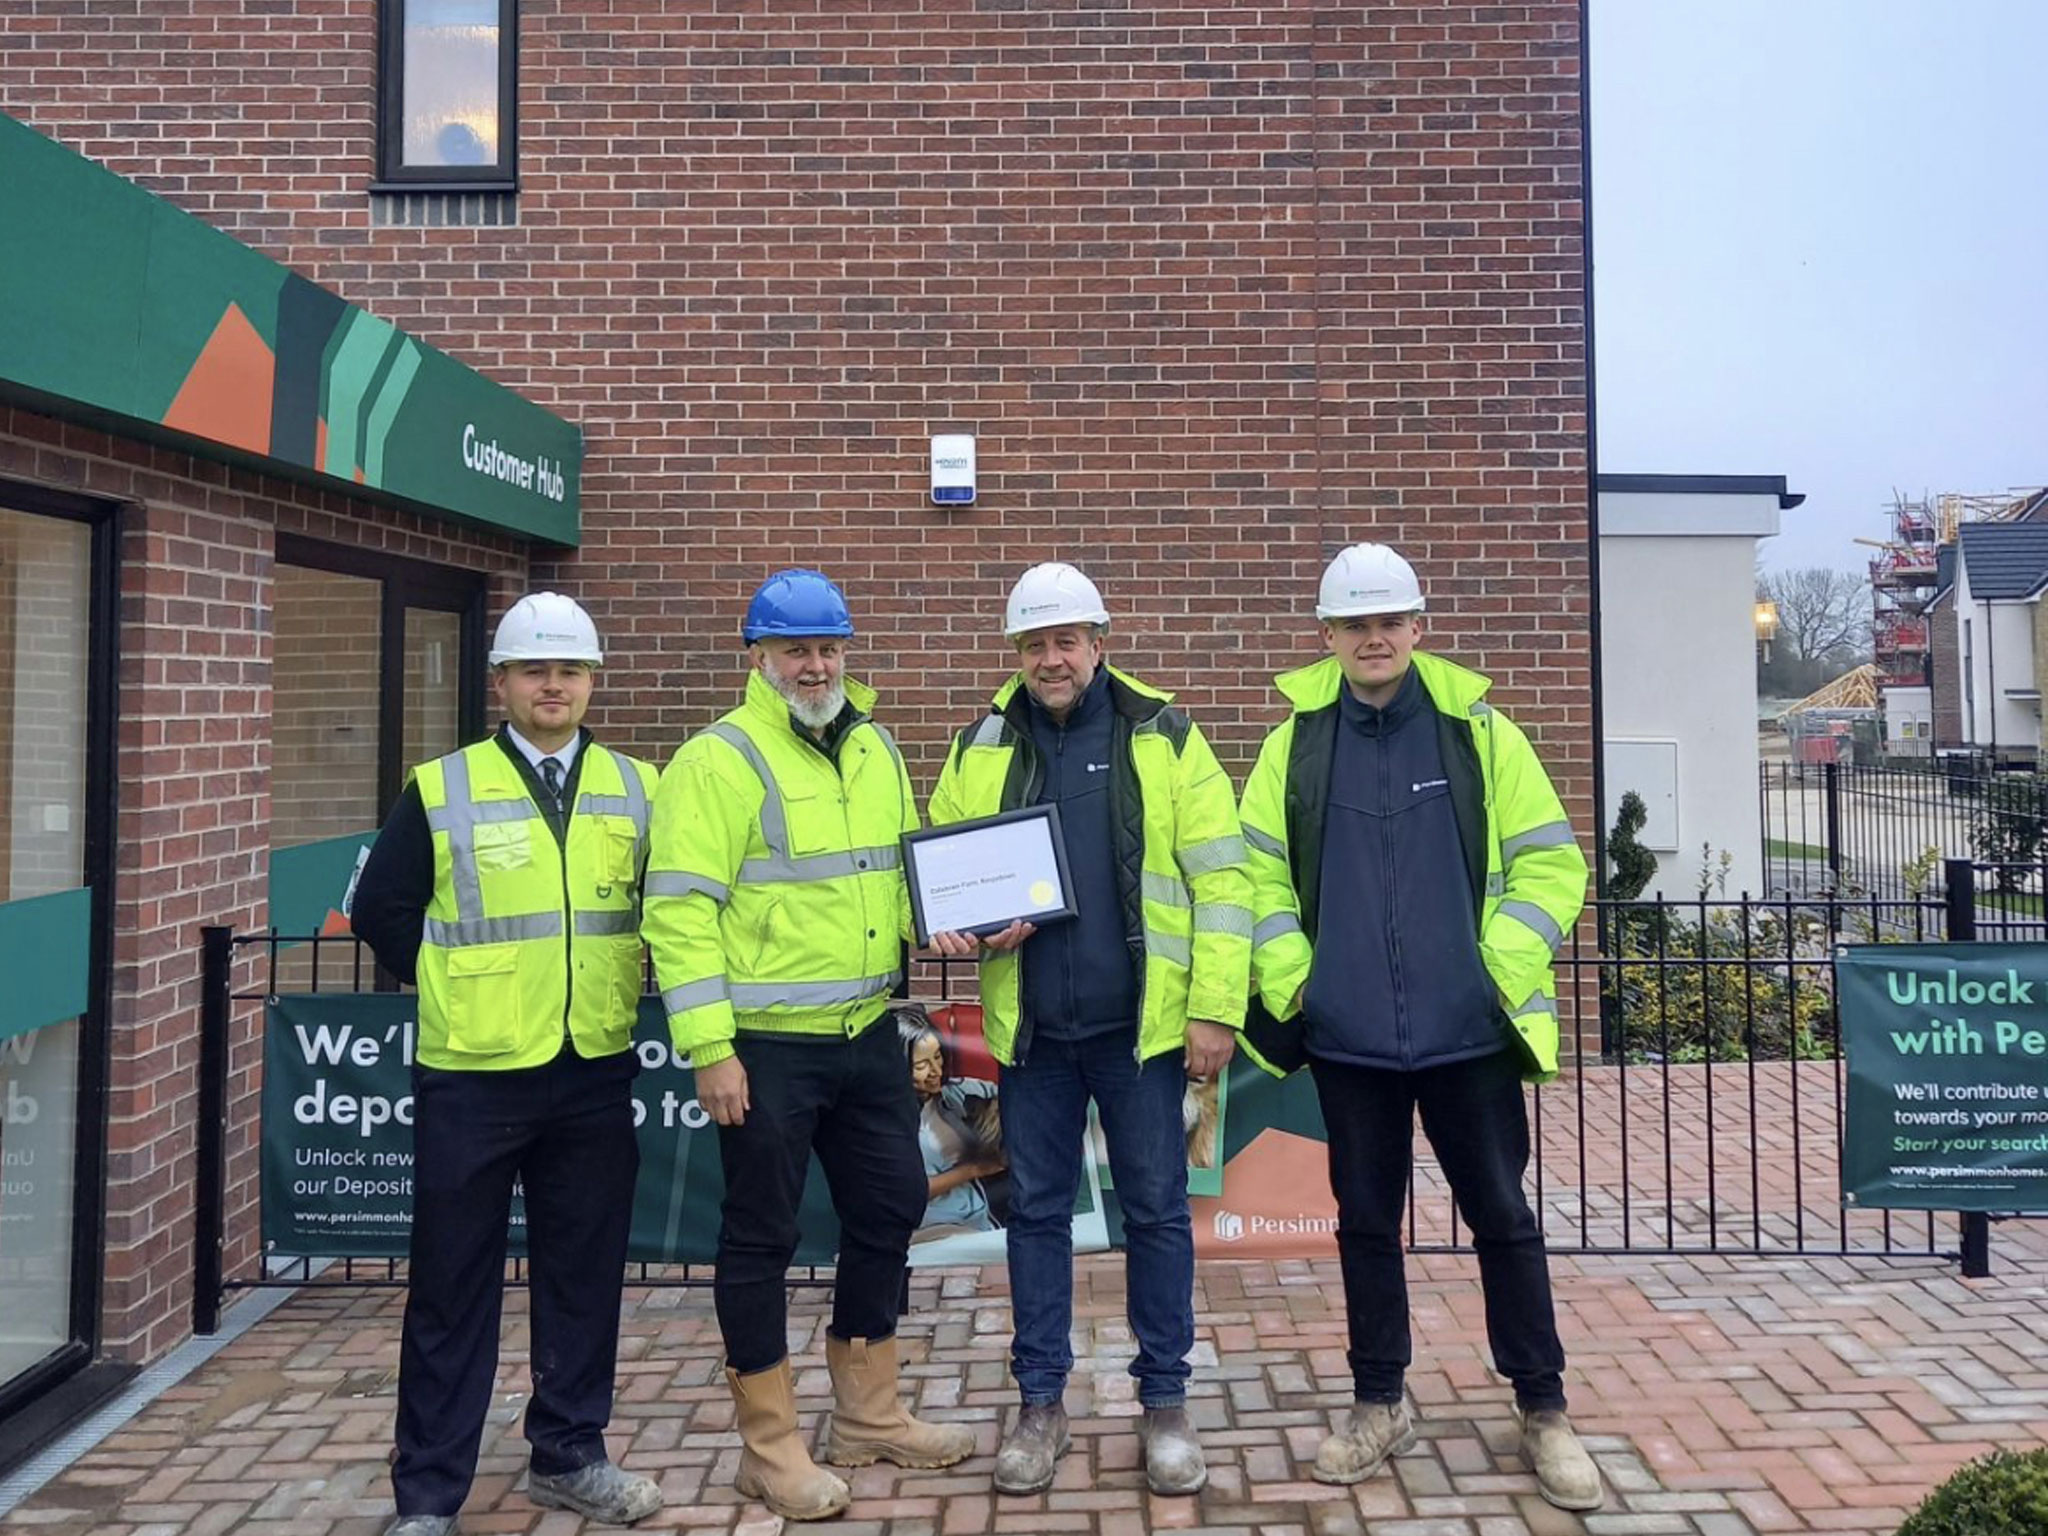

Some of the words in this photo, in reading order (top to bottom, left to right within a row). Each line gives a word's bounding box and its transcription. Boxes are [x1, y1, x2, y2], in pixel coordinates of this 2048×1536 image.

[462, 423, 535, 490] Customer
[537, 455, 565, 502] Hub
[1887, 969, 2034, 1005] Unlock
[1889, 1018, 1983, 1055] with
[1893, 1083, 1939, 1100] We'll
[1944, 1084, 2039, 1100] contribute
[661, 1091, 710, 1129] to
[1894, 1108, 1969, 1125] towards
[1973, 1112, 2017, 1129] your
[1893, 1135, 1939, 1152] Start
[1942, 1139, 1987, 1154] your
[295, 1148, 367, 1167] Unlock
[294, 1180, 328, 1195] our
[334, 1176, 413, 1199] Deposit
